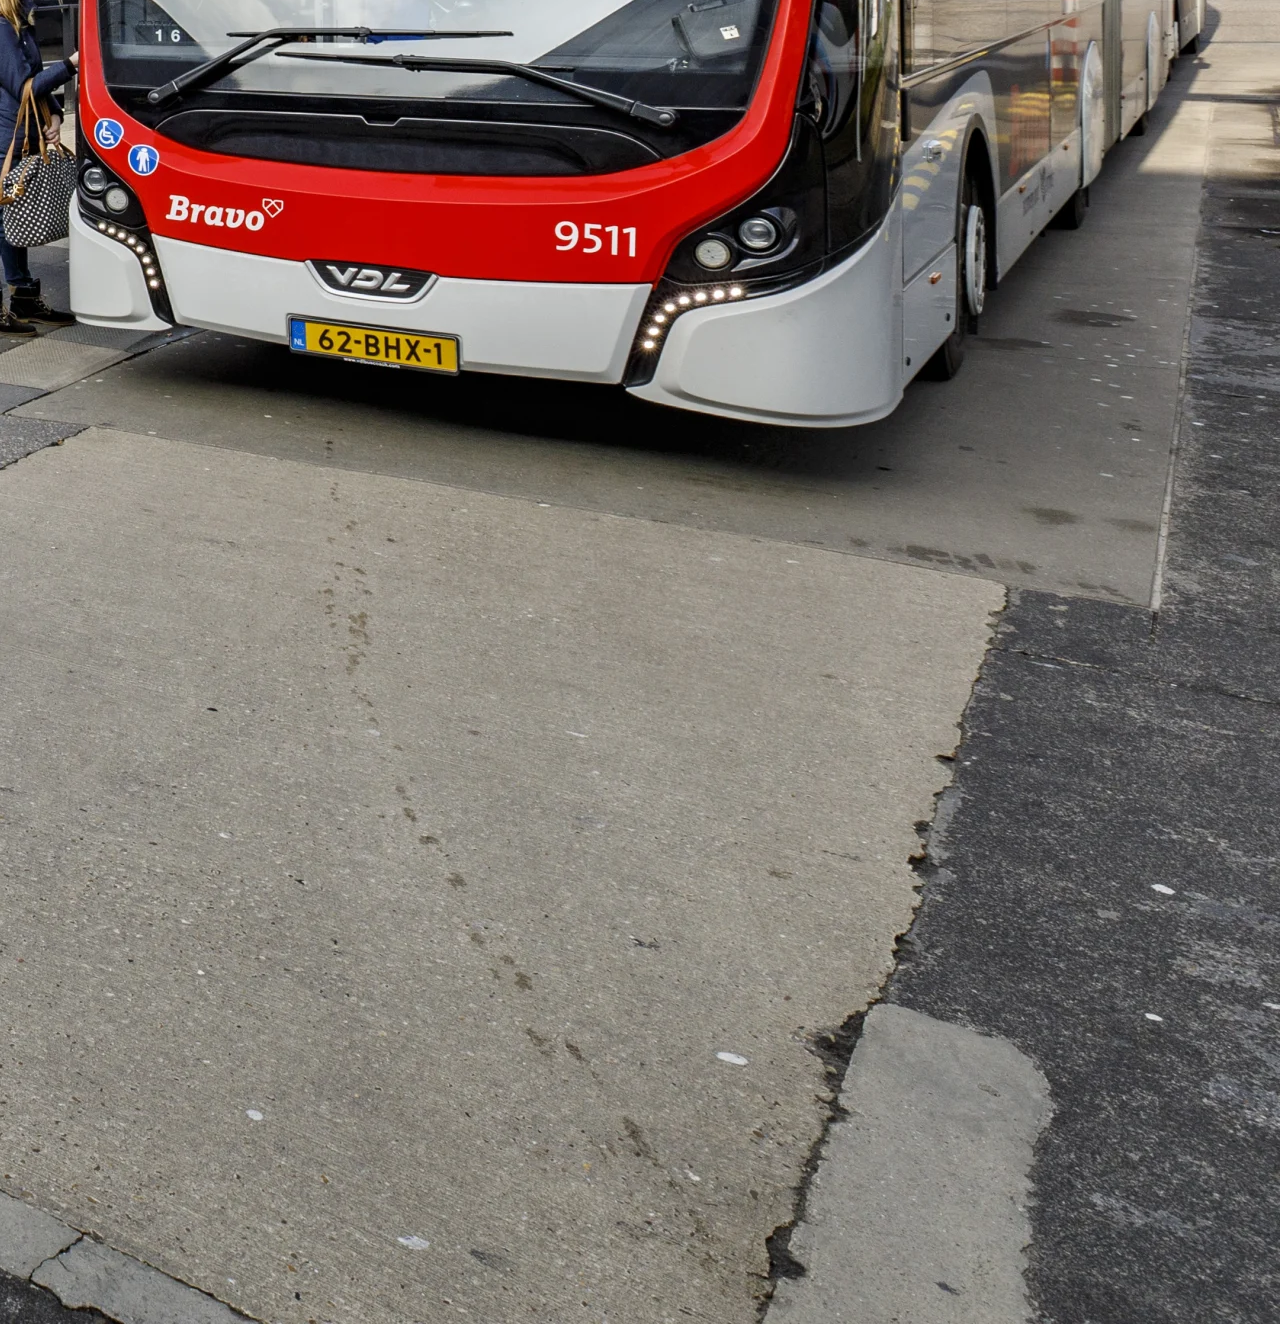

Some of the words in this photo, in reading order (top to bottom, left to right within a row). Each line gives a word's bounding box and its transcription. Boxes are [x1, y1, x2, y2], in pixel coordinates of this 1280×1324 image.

[170, 29, 181, 43] 6
[166, 194, 265, 232] Bravo
[553, 221, 637, 258] 9511
[325, 264, 411, 294] VDL
[293, 338, 305, 347] NL
[318, 327, 444, 366] 62-BHX-1
